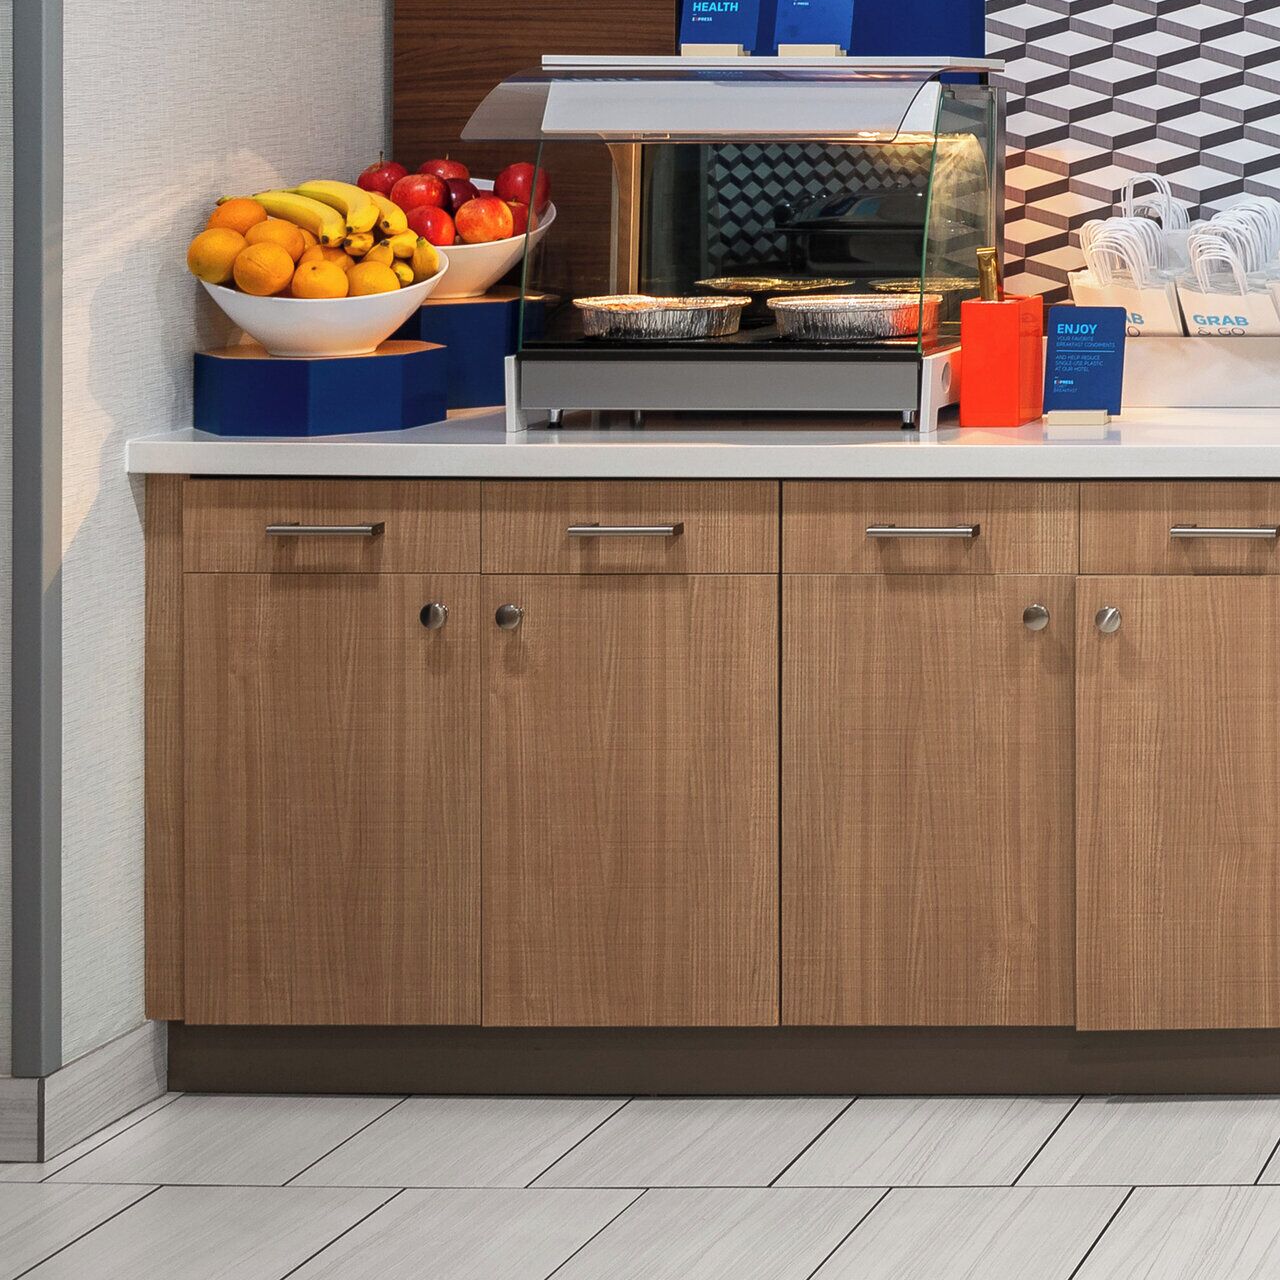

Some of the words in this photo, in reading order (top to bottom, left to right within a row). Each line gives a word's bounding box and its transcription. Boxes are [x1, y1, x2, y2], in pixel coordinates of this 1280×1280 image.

[692, 1, 739, 12] HEALTH
[1192, 314, 1249, 327] GRAB
[1057, 324, 1097, 334] ENJOY
[1217, 327, 1246, 336] GO
